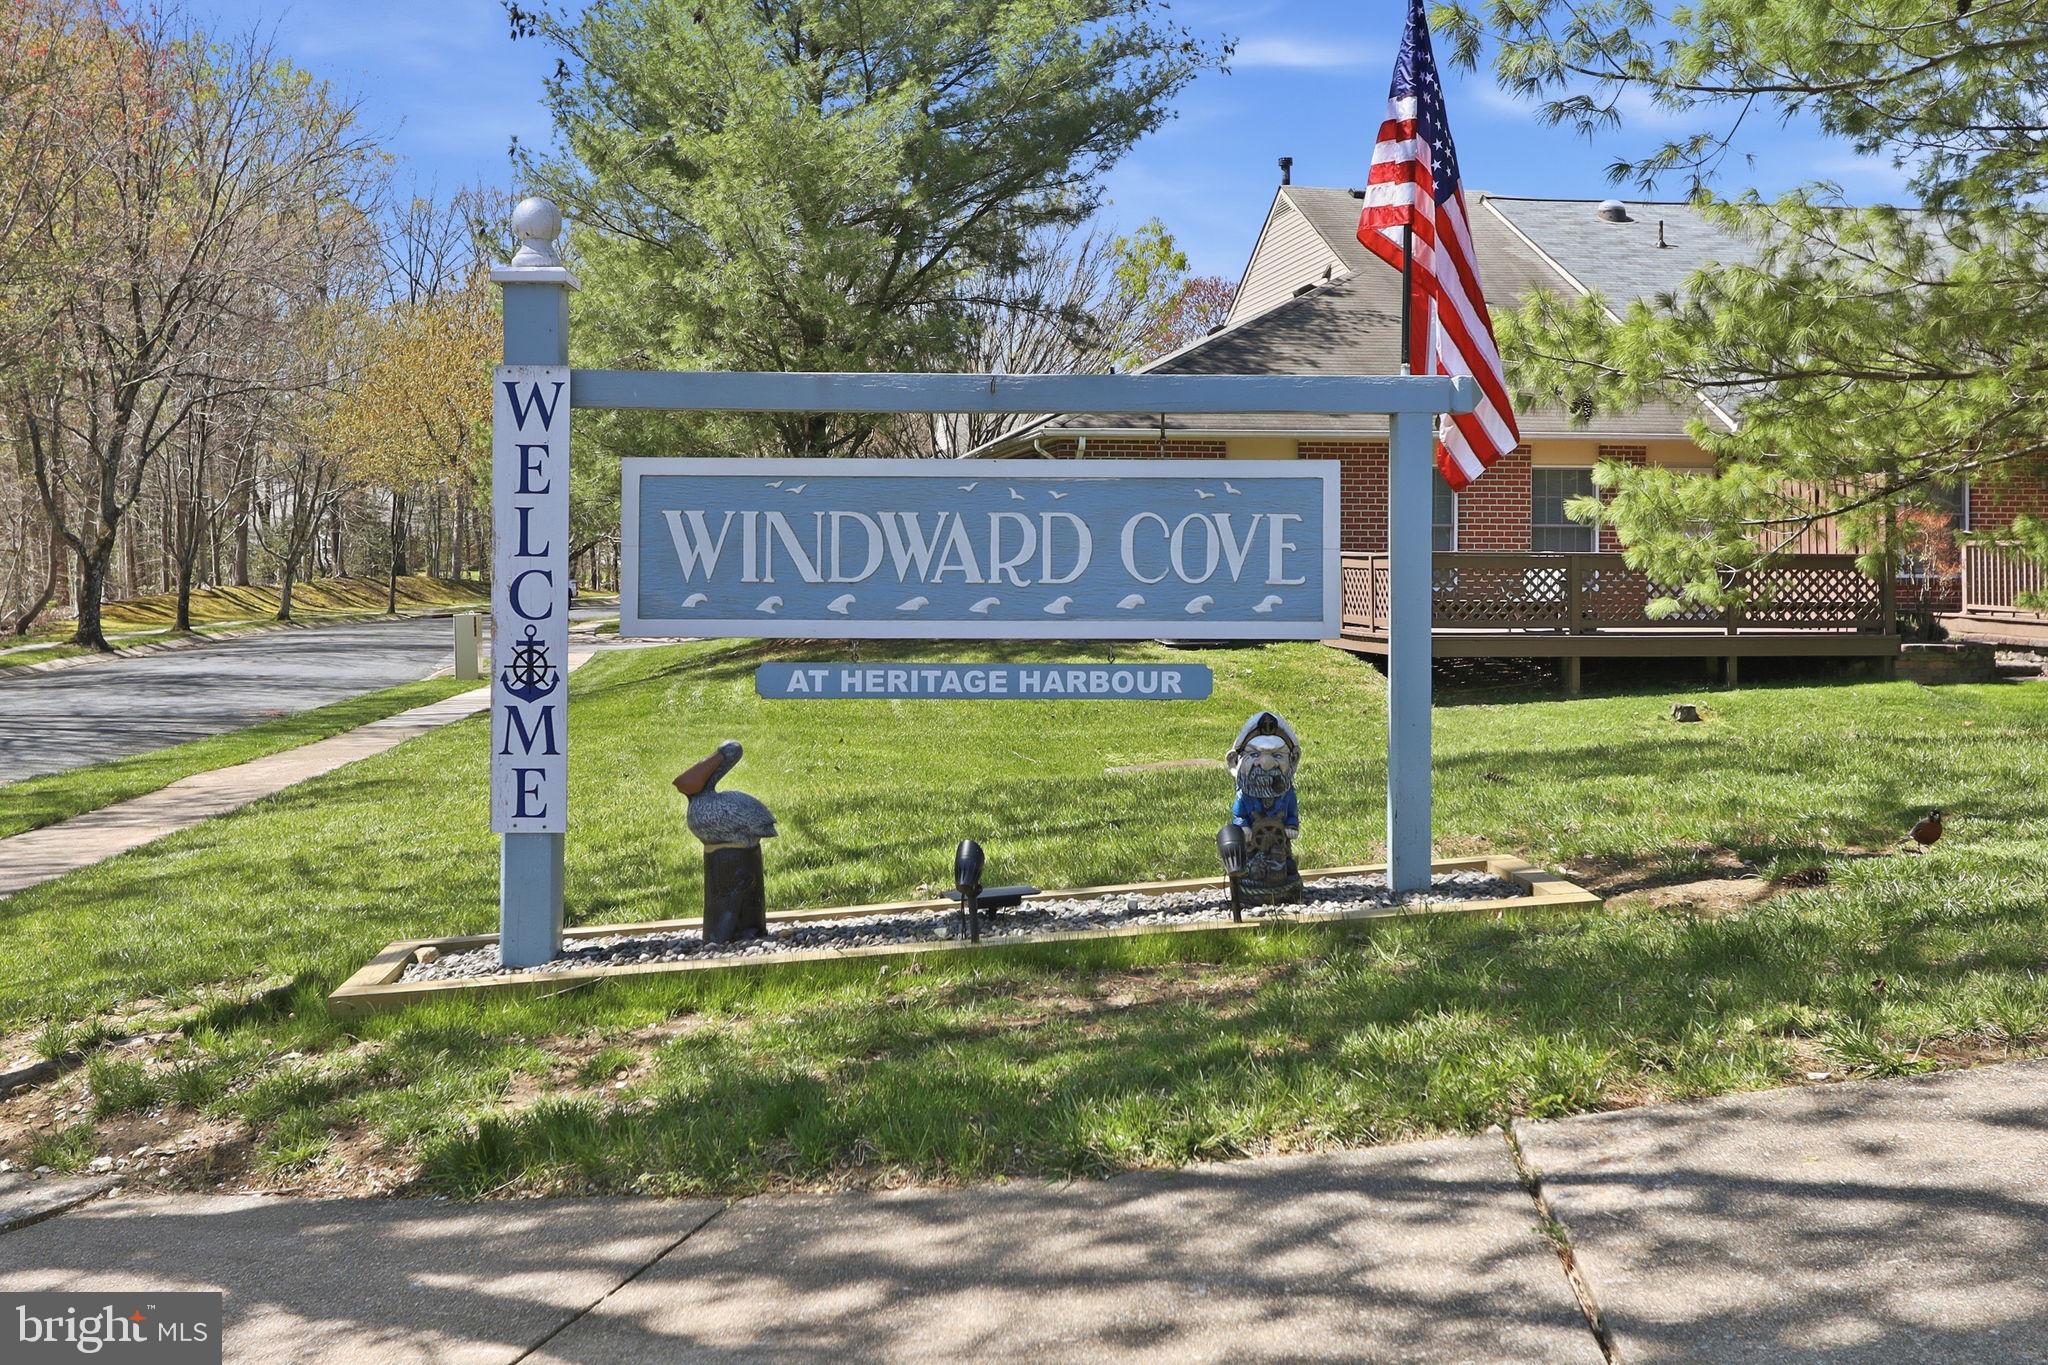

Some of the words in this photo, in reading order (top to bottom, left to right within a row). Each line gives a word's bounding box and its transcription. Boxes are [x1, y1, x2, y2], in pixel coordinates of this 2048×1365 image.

[662, 509, 1094, 588] WINDWARD
[1120, 511, 1306, 586] COVE
[786, 670, 829, 693] AT
[840, 670, 1010, 694] HERITAGE
[1018, 670, 1182, 695] HARBOUR
